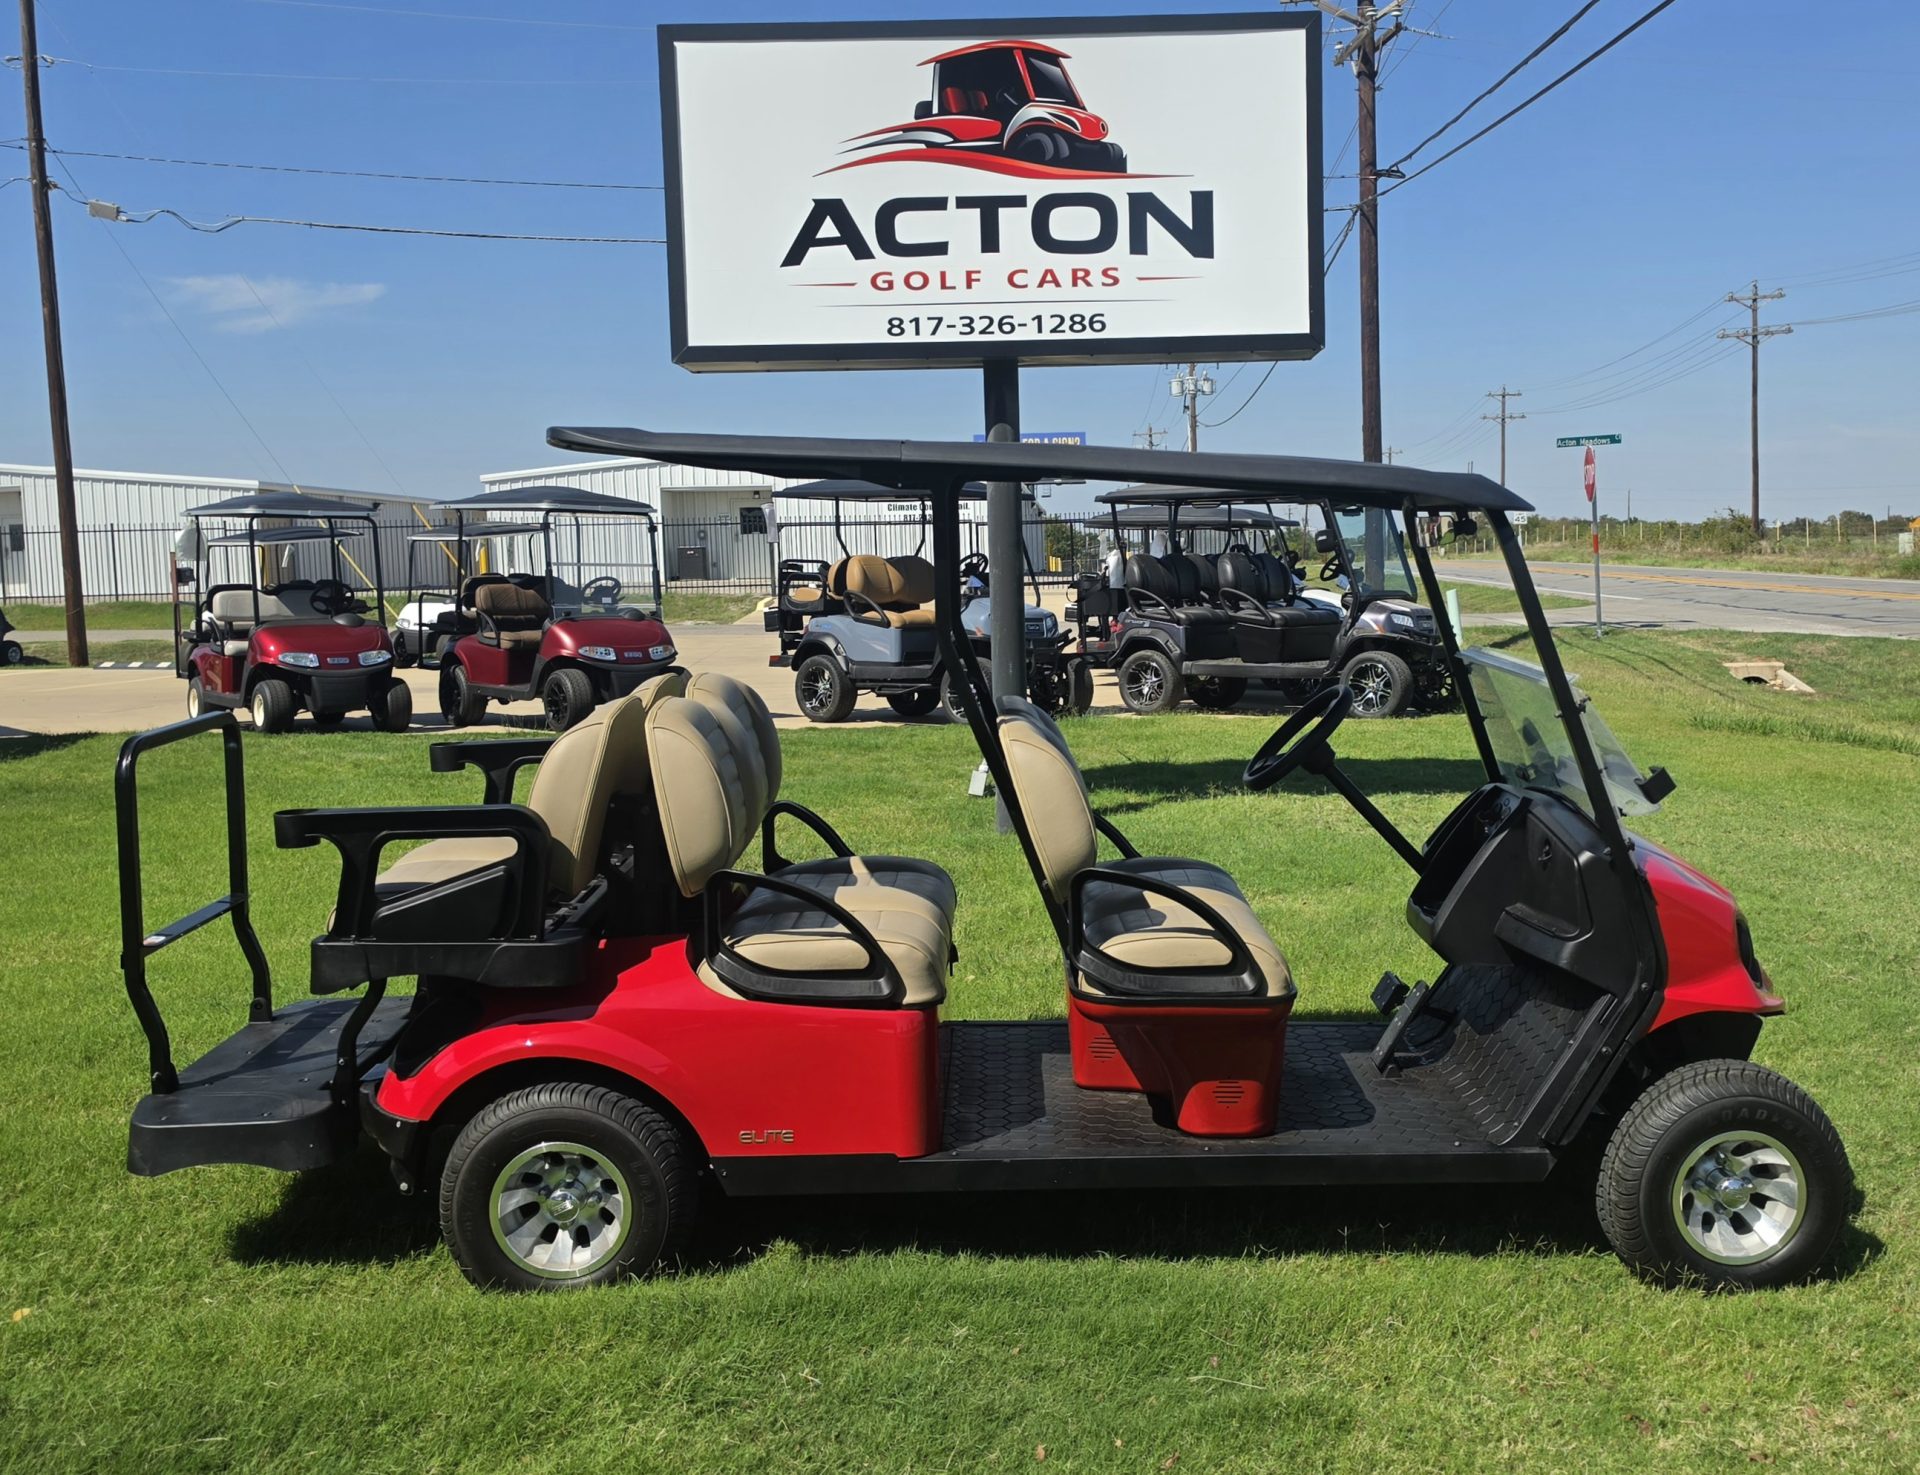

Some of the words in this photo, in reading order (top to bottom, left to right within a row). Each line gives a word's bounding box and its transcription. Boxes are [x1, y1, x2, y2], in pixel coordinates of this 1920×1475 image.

[780, 191, 1214, 268] ACTON
[871, 271, 982, 291] GOLF
[1008, 266, 1121, 288] CARS
[886, 313, 1107, 337] 817-326-1286
[1557, 439, 1577, 447] Acton
[1580, 437, 1611, 446] Meadows
[739, 1129, 795, 1144] ELITE
